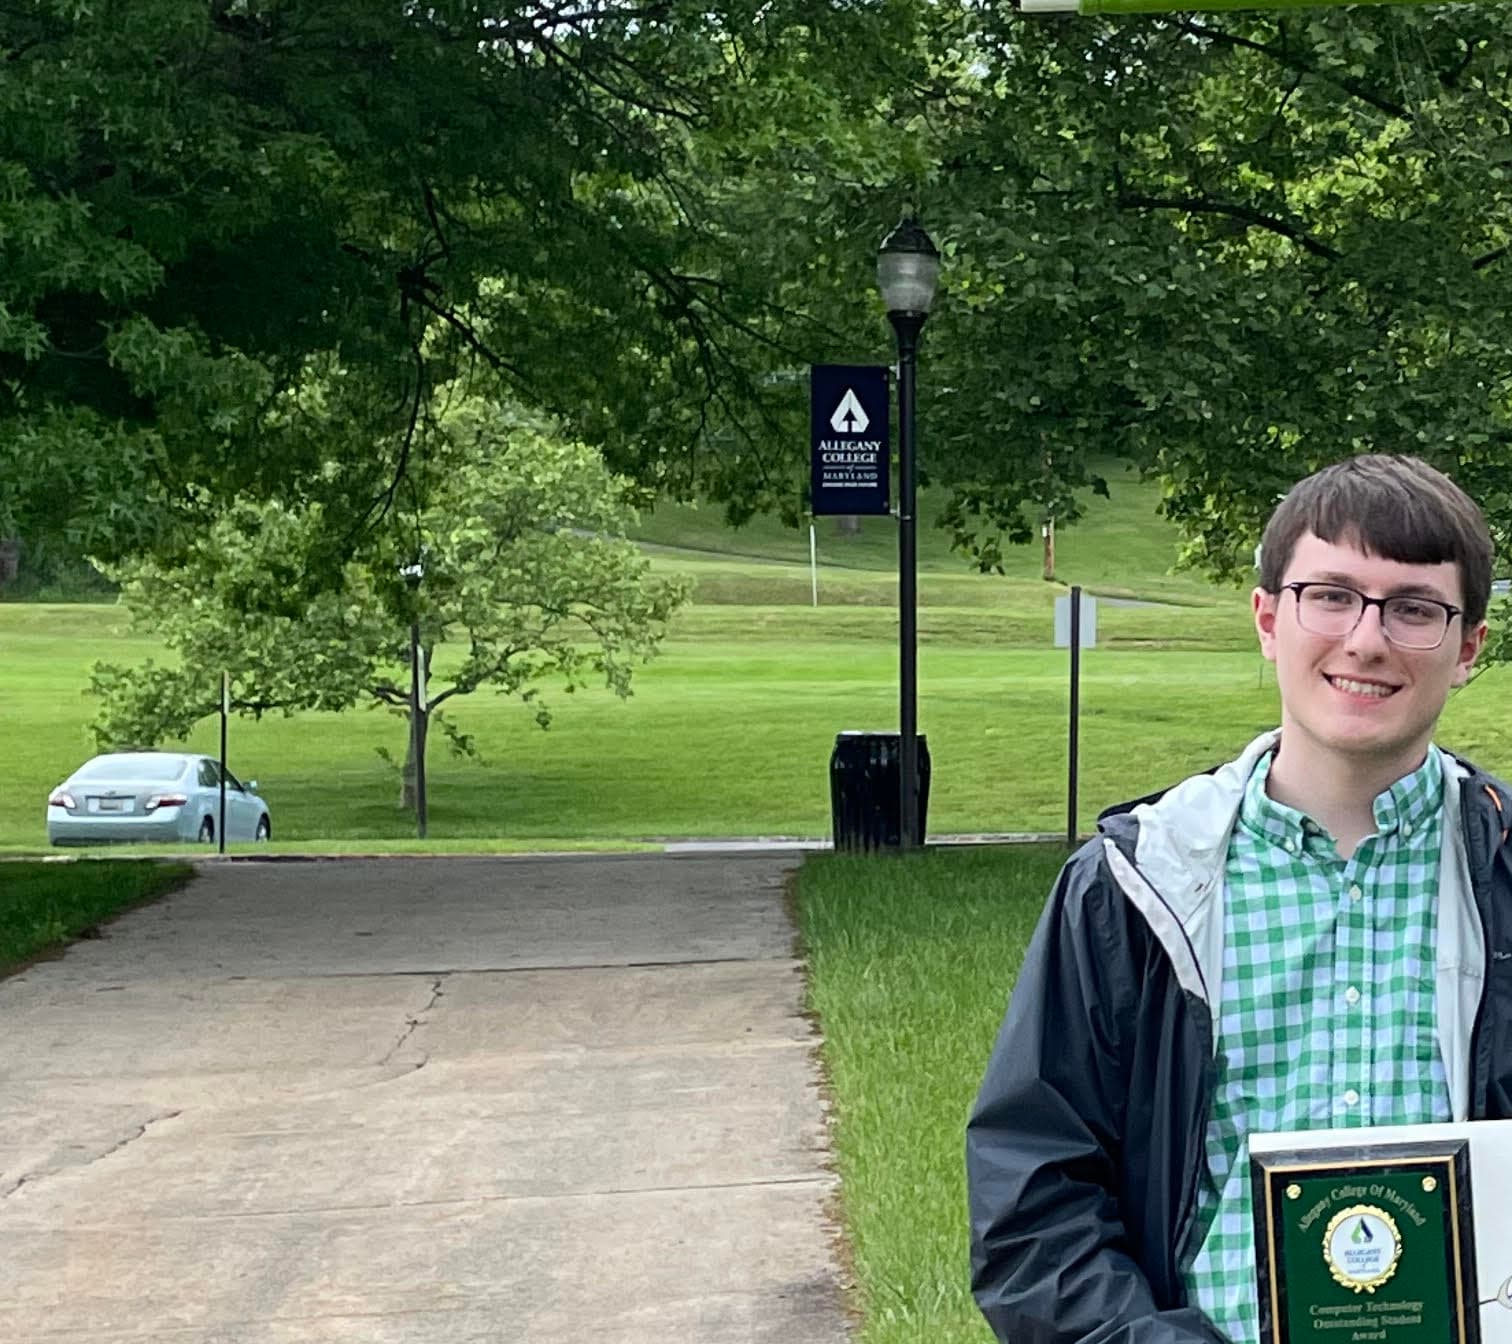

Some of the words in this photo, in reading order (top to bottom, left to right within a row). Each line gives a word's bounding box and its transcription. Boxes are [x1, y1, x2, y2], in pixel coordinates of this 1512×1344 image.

[818, 440, 882, 451] ALLEGANY
[822, 452, 877, 463] COLLEGE
[823, 472, 878, 480] MARYLAND
[1330, 1185, 1367, 1201] College
[1369, 1184, 1384, 1197] Of
[1309, 1304, 1362, 1316] Computer
[1366, 1300, 1424, 1312] Technology
[1313, 1317, 1379, 1329] Outstanding
[1352, 1329, 1387, 1341] Award
